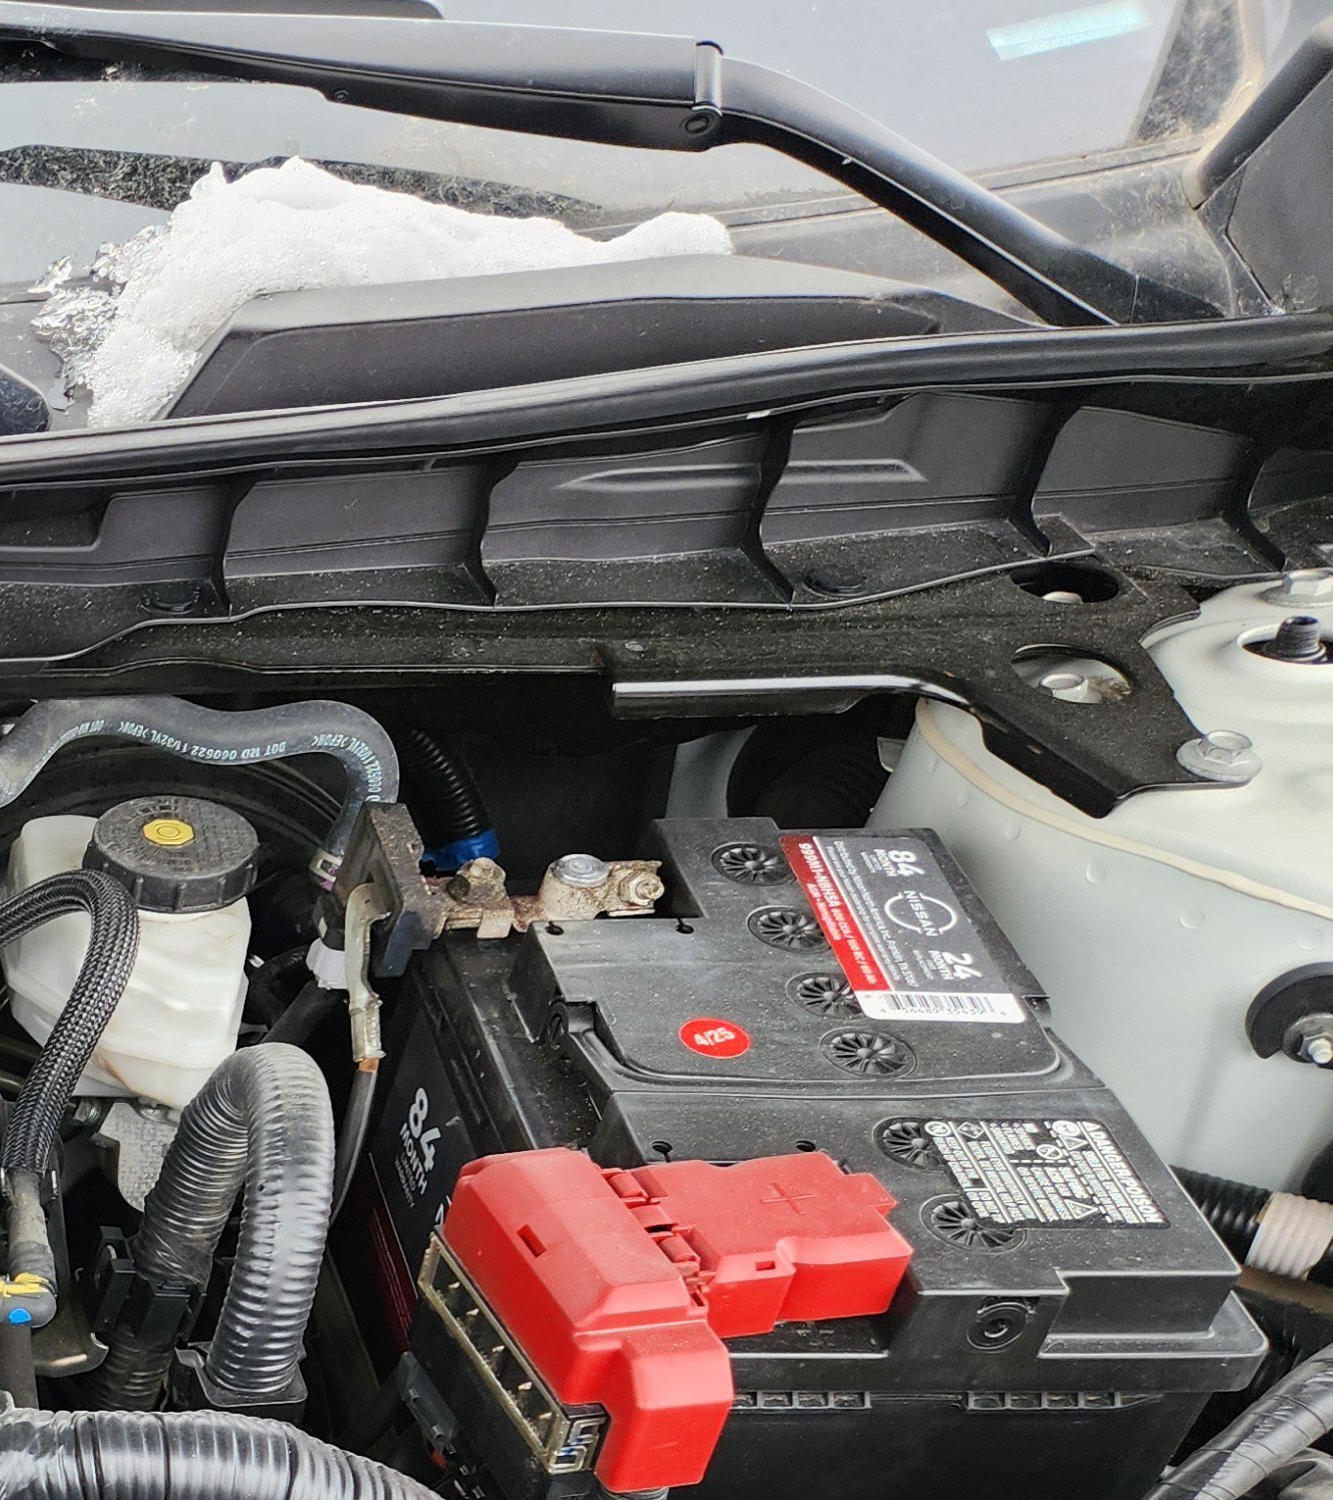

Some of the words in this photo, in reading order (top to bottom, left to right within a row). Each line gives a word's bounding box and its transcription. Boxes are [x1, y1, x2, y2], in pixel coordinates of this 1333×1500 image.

[265, 741, 287, 755] DOT
[872, 849, 897, 876] MONTH
[885, 850, 926, 876] 84
[902, 890, 938, 936] NISSAN
[927, 950, 953, 979] MONTH
[941, 952, 983, 979] 24
[693, 1027, 735, 1045] 4/25
[408, 1087, 441, 1173] 84
[399, 1123, 427, 1195] MONTH
[1088, 1131, 1164, 1222] DANGER/POISON
